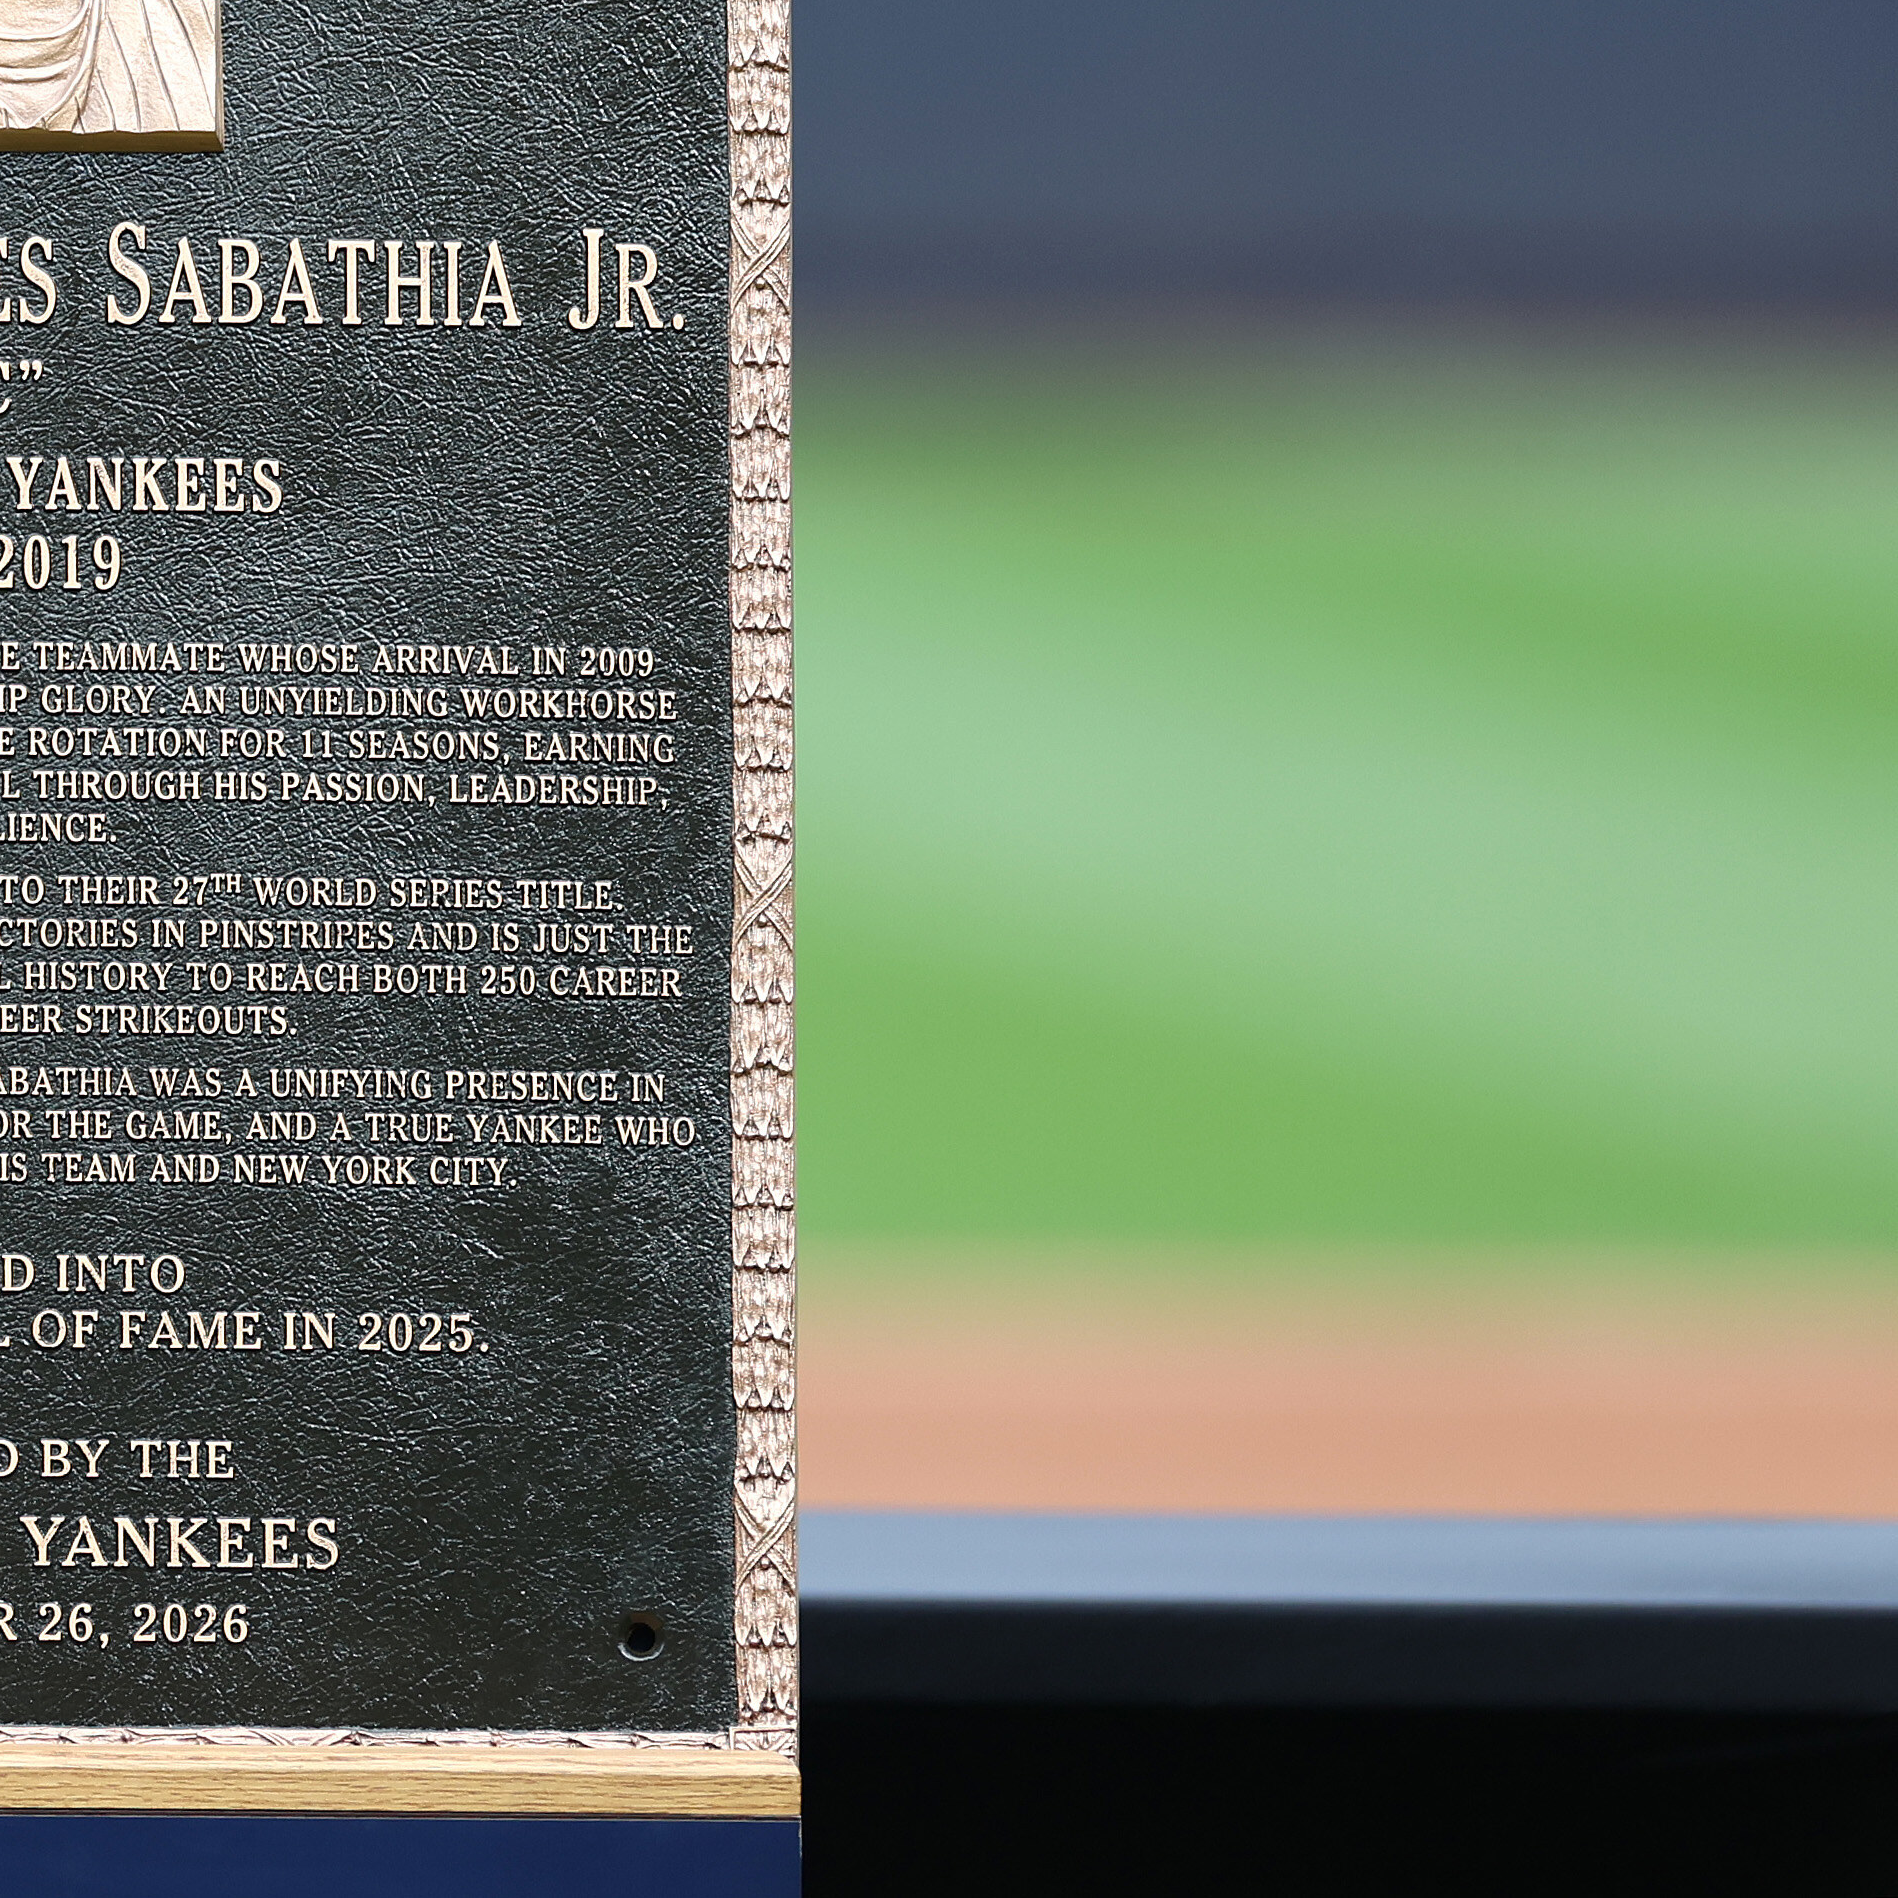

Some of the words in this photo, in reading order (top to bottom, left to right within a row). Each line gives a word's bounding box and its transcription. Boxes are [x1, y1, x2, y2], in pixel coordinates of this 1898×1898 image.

[5, 455, 282, 513] YANKEES
[32, 640, 224, 672] TEAMMATE
[239, 642, 359, 673] WHOSE
[371, 644, 521, 675] ARRIVAL
[531, 645, 566, 675] IN
[580, 646, 654, 677] 2009
[41, 684, 166, 714] GLORY.
[179, 685, 225, 715] AN
[240, 685, 448, 717] UNYIELDING
[459, 688, 677, 720] WORKHORSE
[28, 726, 207, 758] ROTATION
[220, 728, 286, 758] FOR
[302, 728, 331, 758] 11
[349, 729, 510, 763] SEASONS,
[524, 732, 674, 763] EARNING
[32, 769, 204, 800] THROUGH
[214, 771, 267, 801] HIS
[280, 772, 436, 808] PASSION,
[449, 773, 667, 811] LEADERSHIP,
[57, 875, 161, 905] THEIR
[252, 876, 377, 907] WORLD
[390, 878, 503, 909] SERIES
[515, 879, 624, 910] TITLE.
[151, 918, 186, 948] IN
[199, 919, 394, 950] PINSTRIPES
[406, 922, 478, 951] AND
[491, 922, 520, 952] IS
[532, 922, 615, 953] JUST
[626, 924, 693, 954] THE
[24, 960, 174, 991] HISTORY
[185, 962, 232, 992] TO
[247, 962, 360, 993] REACH
[373, 963, 467, 994] BOTH
[480, 965, 536, 996] 250
[550, 966, 684, 997] CAREER
[75, 1004, 297, 1035] STRIKEOUTS.
[149, 1067, 223, 1097] WAS
[234, 1068, 259, 1097] A
[270, 1068, 432, 1100] UNIFYING
[445, 1069, 618, 1102] PRESENCE
[629, 1073, 665, 1102] IN
[45, 1109, 112, 1139] THE
[125, 1110, 232, 1145] GAME,
[245, 1110, 317, 1141] AND
[329, 1112, 353, 1141] A
[364, 1112, 454, 1142] TRUE
[465, 1113, 601, 1144] YANKEE
[614, 1115, 696, 1146] WHO
[41, 1152, 136, 1183] TEAM
[148, 1153, 220, 1183] AND
[233, 1154, 310, 1184] NEW
[321, 1154, 417, 1185] YORK
[429, 1155, 517, 1186] CITY.
[56, 1253, 185, 1293] INTO
[32, 1308, 99, 1348] OF
[119, 1310, 262, 1350] FAME
[283, 1311, 339, 1350] IN
[358, 1312, 489, 1353] 2025.
[40, 1438, 110, 1478] BY
[130, 1439, 234, 1479] THE
[19, 1515, 339, 1570] YANKEES
[38, 1602, 109, 1649] 26,
[133, 1603, 249, 1643] 2026
